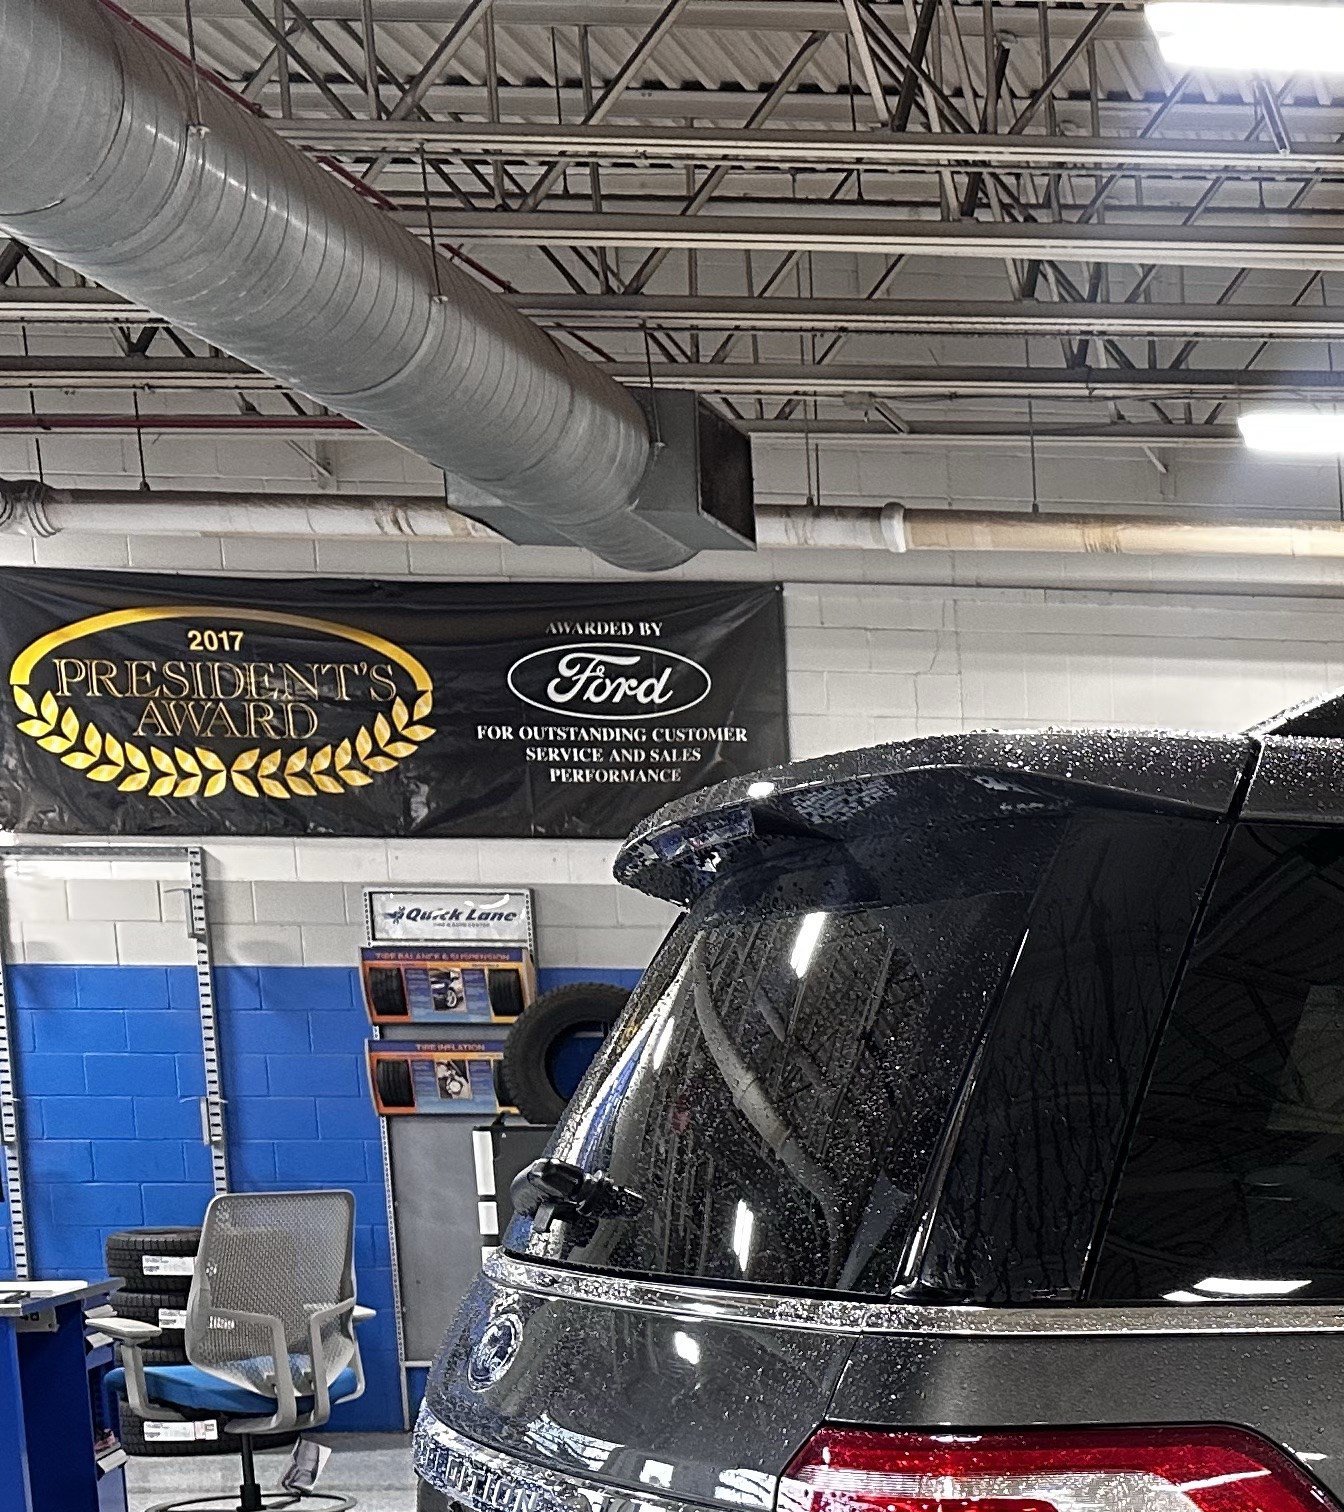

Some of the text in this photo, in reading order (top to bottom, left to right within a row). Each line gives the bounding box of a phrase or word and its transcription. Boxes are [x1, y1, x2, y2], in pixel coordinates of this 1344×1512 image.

[546, 621, 663, 637] AWARDED BY
[187, 630, 244, 652] 2017
[52, 658, 397, 701] PRESIDENT'S
[546, 652, 674, 704] Ford
[132, 700, 319, 740] AWARD
[477, 725, 748, 743] FOR OUTSTANDING CUSTOMER
[525, 747, 702, 763] SERVICE AND SALES
[550, 767, 682, 784] PERFORMANCE
[466, 908, 517, 922] Lane
[416, 1043, 485, 1051] TIRE INFLATION
